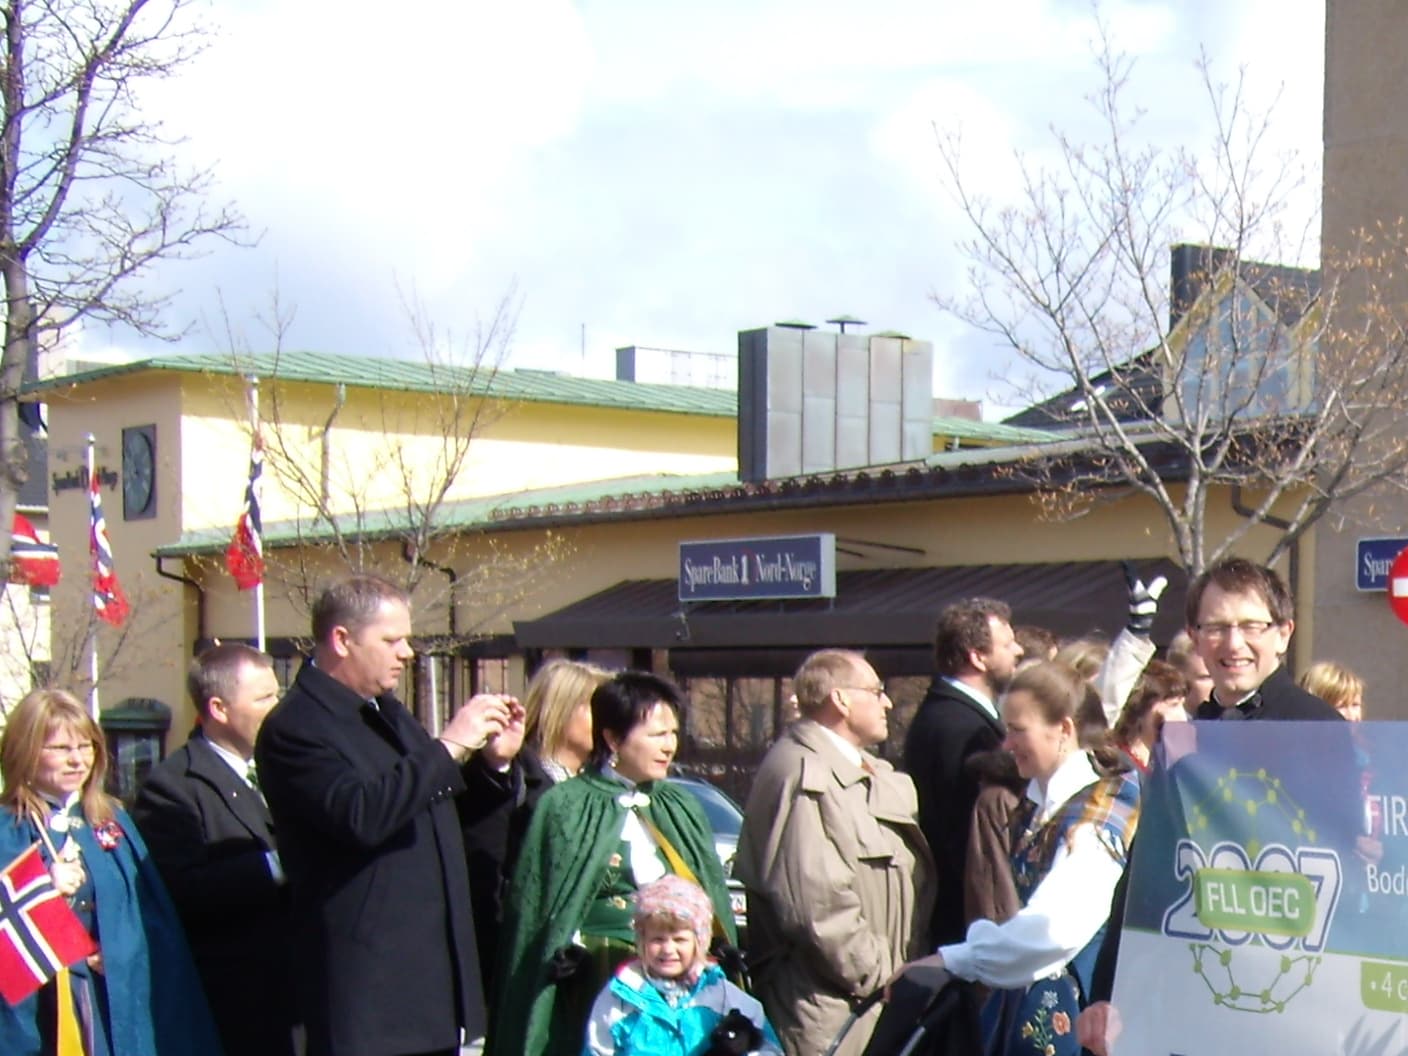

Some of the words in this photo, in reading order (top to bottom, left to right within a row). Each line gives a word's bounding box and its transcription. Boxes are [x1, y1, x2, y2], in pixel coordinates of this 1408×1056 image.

[685, 556, 739, 592] SpareBank
[741, 555, 749, 585] 1
[755, 552, 816, 591] Nord-Norge
[1206, 881, 1246, 915] FLL
[1250, 886, 1300, 919] OEC
[1381, 974, 1393, 999] 4
